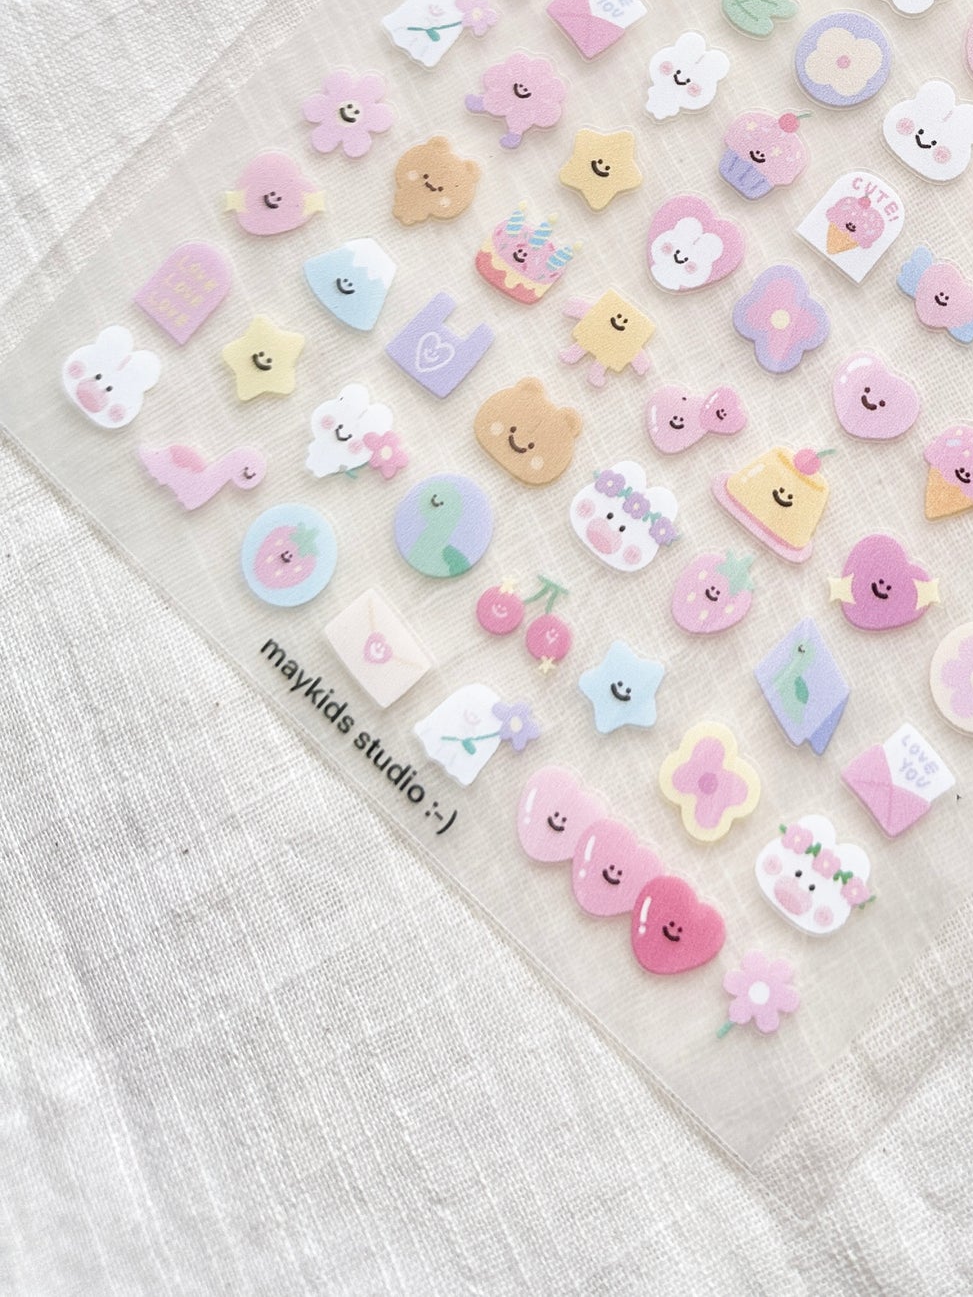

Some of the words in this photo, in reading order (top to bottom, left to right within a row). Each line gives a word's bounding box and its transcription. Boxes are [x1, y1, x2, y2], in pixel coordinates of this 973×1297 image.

[851, 177, 900, 222] CUTE!
[260, 638, 355, 735] maykids
[353, 731, 425, 804] studio
[898, 757, 931, 788] YOU
[901, 734, 940, 775] LOVE
